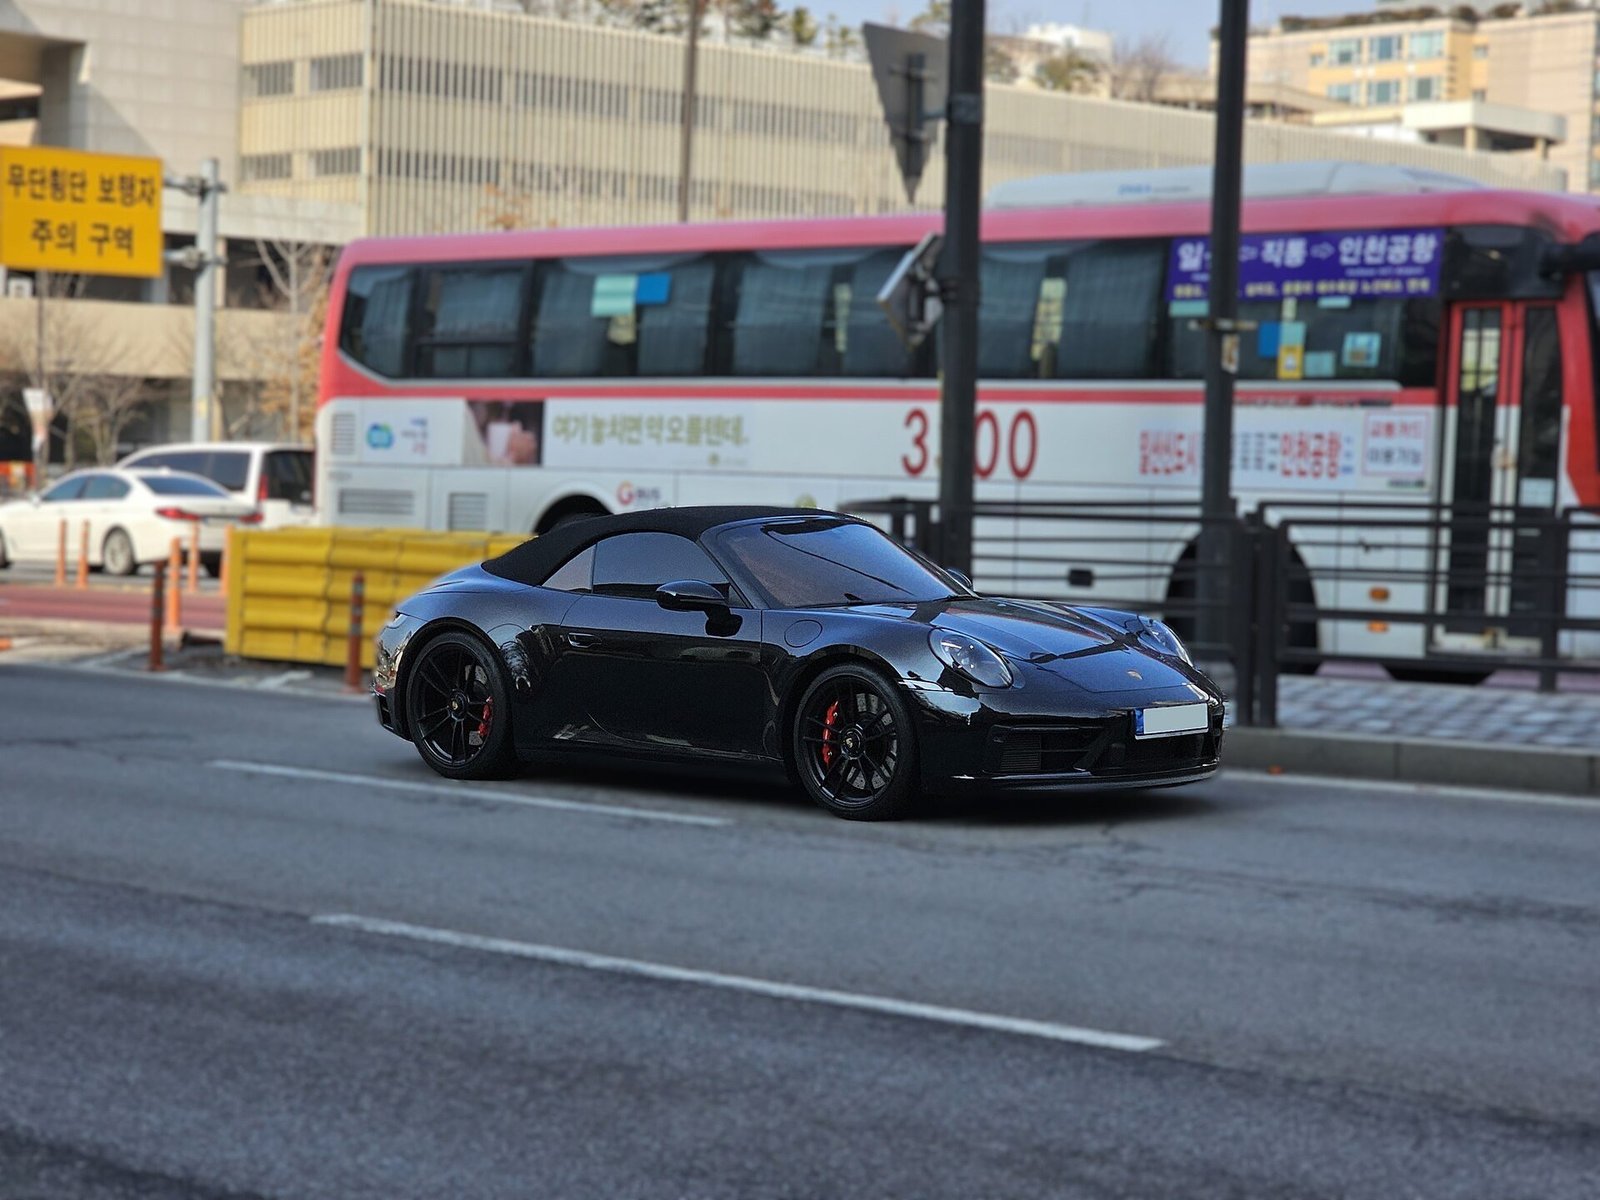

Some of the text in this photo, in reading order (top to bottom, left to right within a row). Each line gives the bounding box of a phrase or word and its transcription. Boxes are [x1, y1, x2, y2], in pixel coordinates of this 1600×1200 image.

[8, 164, 156, 208] 무단횡단 보행자
[31, 218, 134, 258] 주의 구역
[1178, 233, 1438, 271] 일 직통 인천공항
[902, 407, 1038, 481] 300
[1280, 431, 1343, 480] 인천공항
